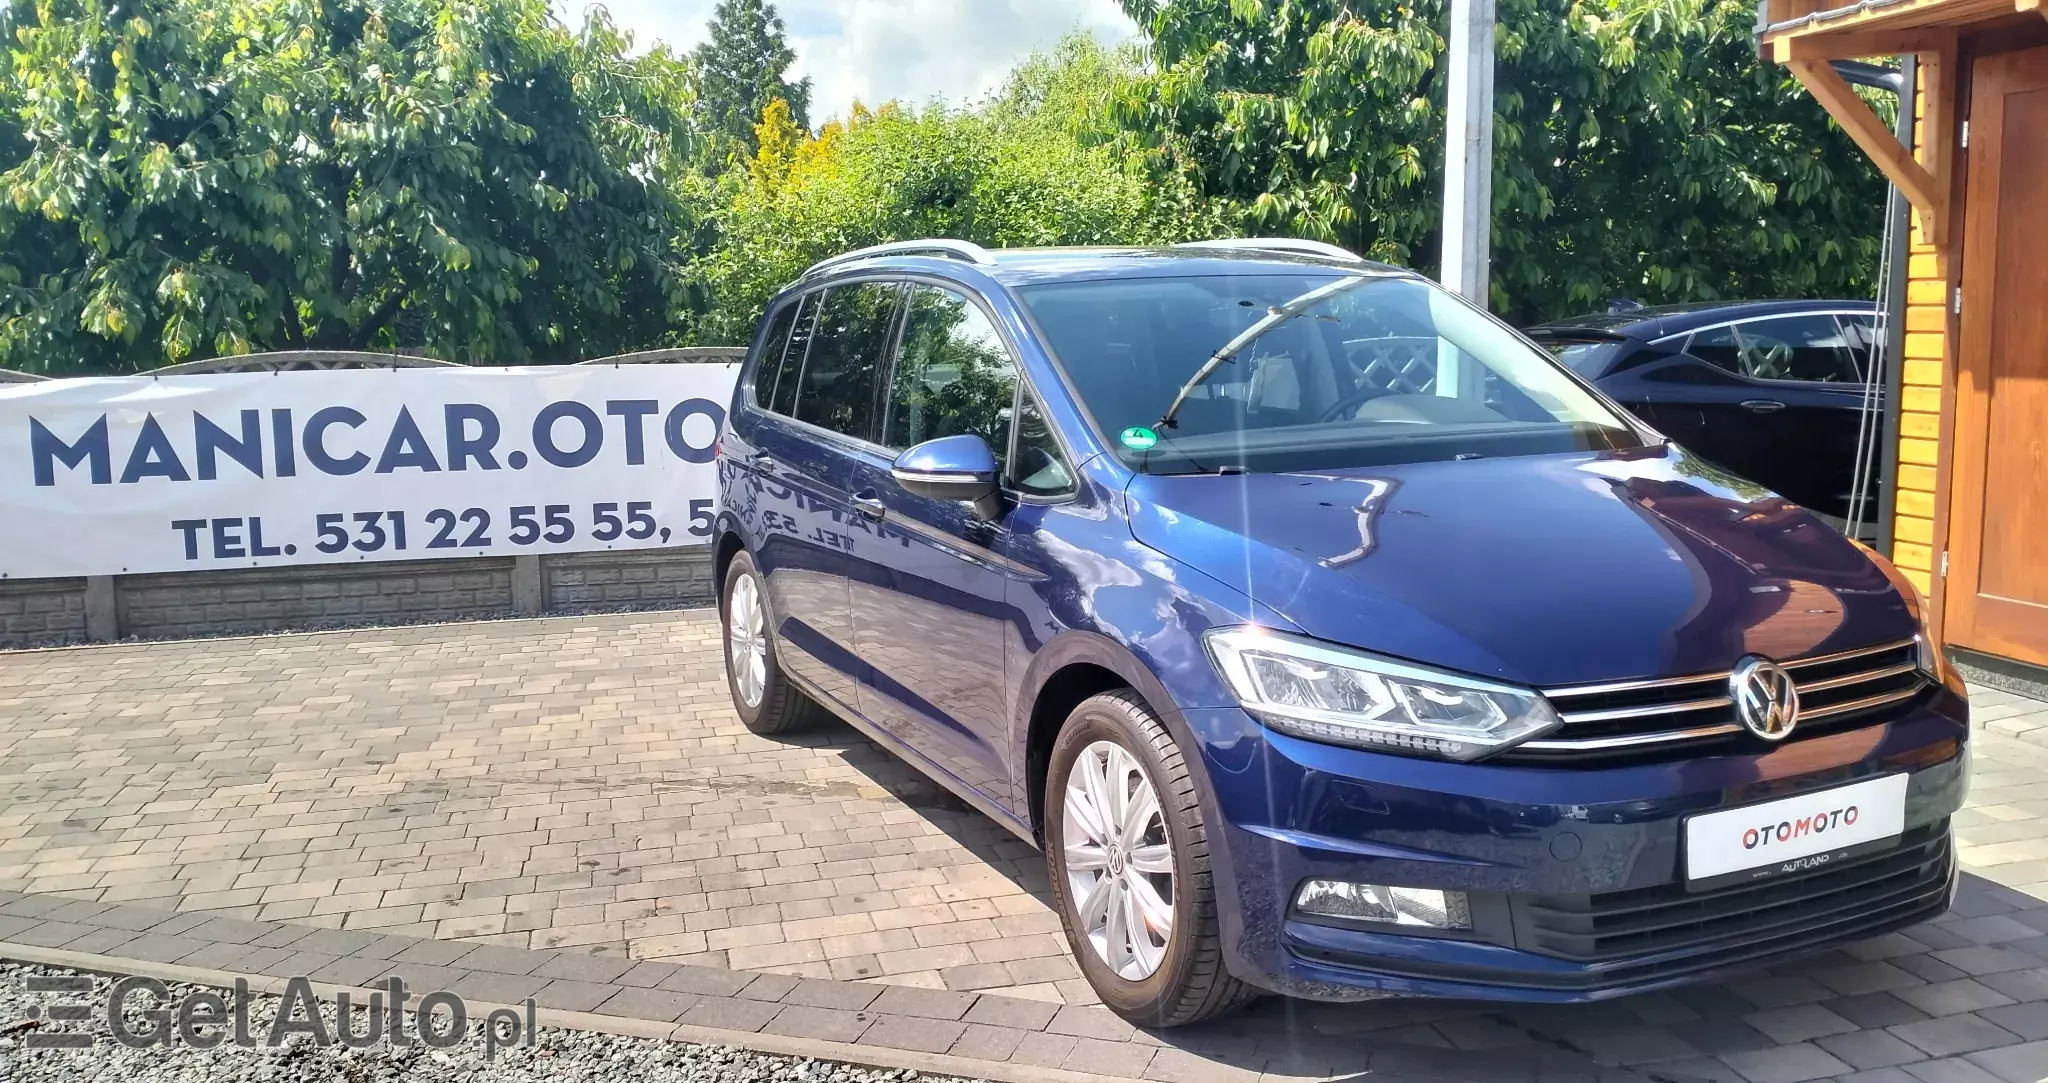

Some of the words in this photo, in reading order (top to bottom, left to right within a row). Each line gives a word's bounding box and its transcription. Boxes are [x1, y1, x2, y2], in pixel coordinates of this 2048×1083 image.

[1133, 429, 1144, 439] 4
[171, 516, 298, 561] TEL.
[315, 511, 405, 553] 531
[425, 508, 492, 549] 22
[509, 505, 575, 546] 55
[591, 501, 672, 544] 55,
[1742, 804, 1859, 850] OTOMOTO
[1781, 854, 1830, 872] AUTOLAND
